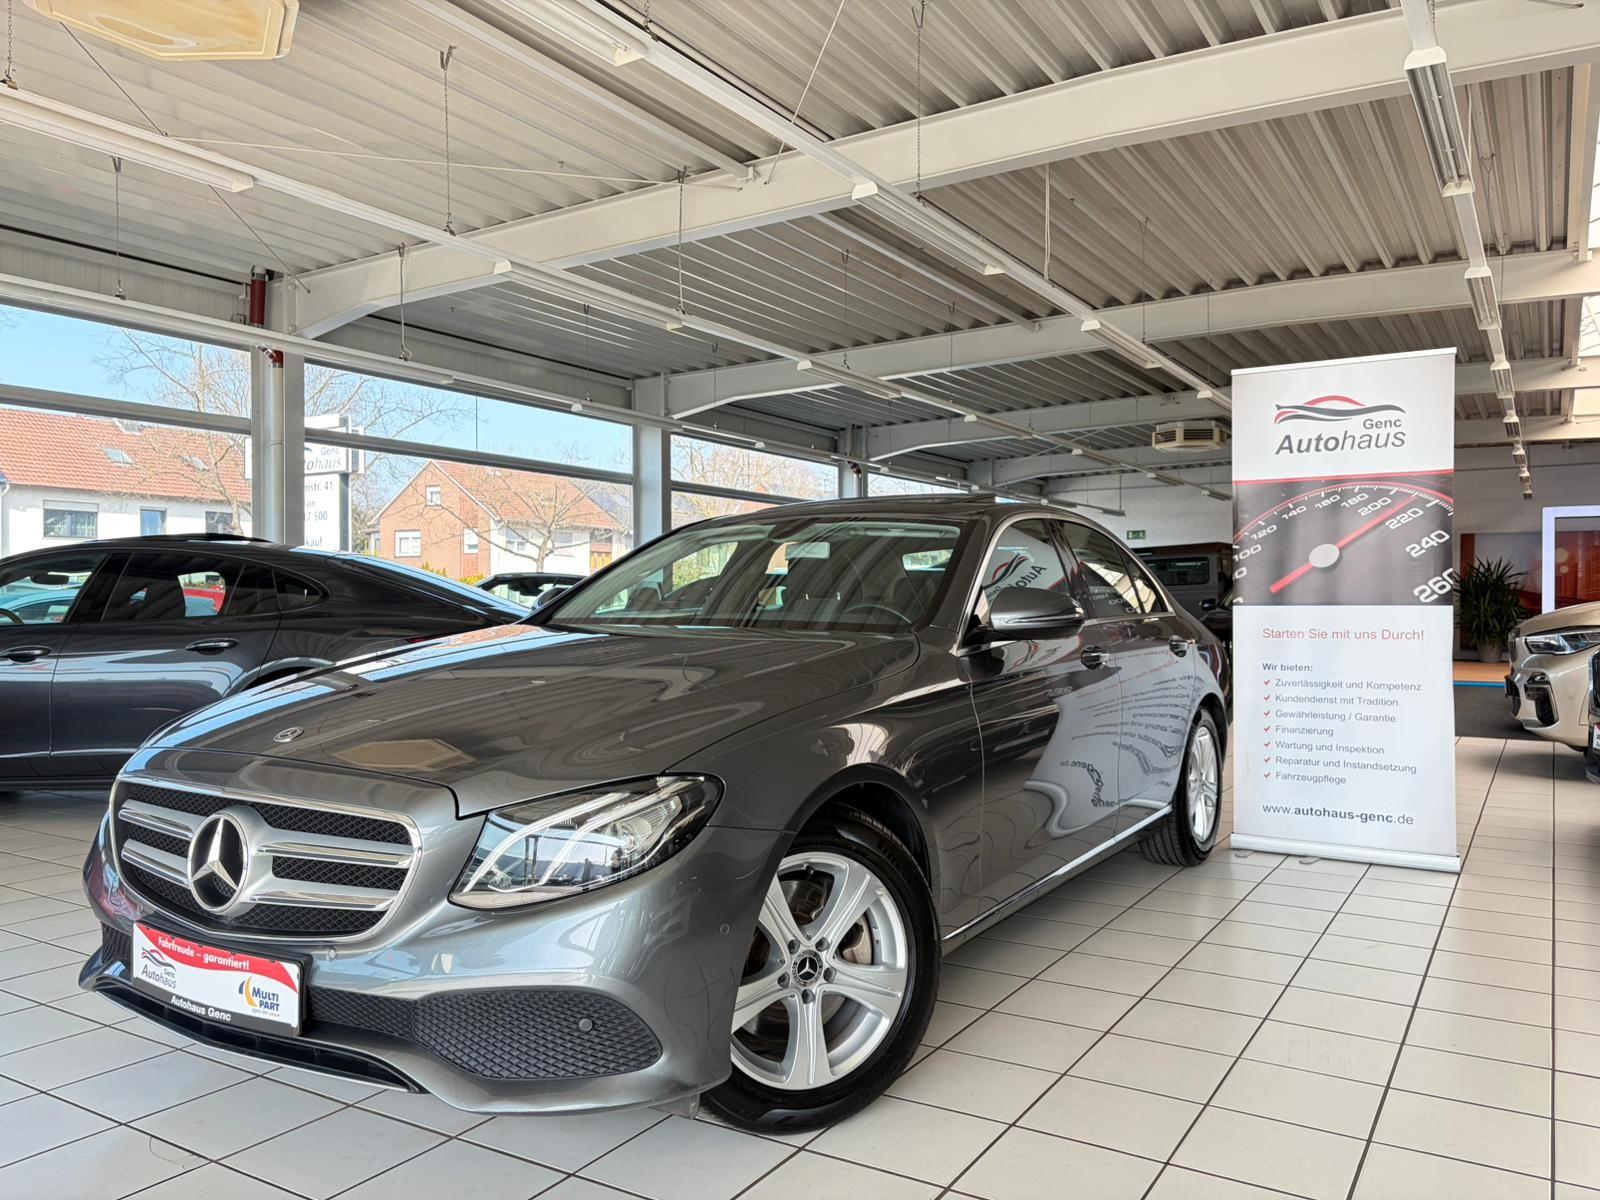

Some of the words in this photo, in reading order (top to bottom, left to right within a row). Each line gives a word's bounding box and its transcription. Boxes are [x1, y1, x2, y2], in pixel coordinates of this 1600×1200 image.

[1362, 418, 1402, 430] Genc
[1275, 430, 1406, 455] Autohaus
[305, 457, 342, 471] ohaus
[305, 483, 321, 492] nstr.
[1315, 495, 1341, 508] 160
[1341, 493, 1369, 508] 180
[1358, 497, 1392, 516] 200
[1282, 506, 1308, 520] 140
[1386, 507, 1424, 530] 220
[1250, 524, 1278, 541] 120
[305, 536, 322, 547] kauf
[1406, 530, 1450, 559] 240
[1233, 544, 1262, 562] 100
[1262, 629, 1304, 639] Starten
[1309, 629, 1327, 639] Sie
[1332, 630, 1350, 640] mit
[1355, 631, 1377, 640] uns
[1382, 630, 1424, 641] Durch!
[1262, 663, 1277, 671] Wir
[1281, 664, 1313, 672] bieten:
[1275, 678, 1343, 690] Zuverlässigkeit
[1346, 681, 1364, 689] und
[1366, 681, 1422, 692] Kompetenz
[1275, 695, 1337, 705] Kundendienst
[1340, 697, 1354, 705] mit
[1357, 697, 1399, 706] Tradition
[1275, 710, 1346, 722] Gewährleistung
[1355, 713, 1396, 722] Garantie
[1275, 726, 1334, 737] Finanzierung
[1275, 741, 1313, 752] Wartung
[1316, 743, 1333, 752] und
[1336, 745, 1384, 755] Inspektion
[1275, 757, 1320, 767] Reparatur
[1323, 759, 1340, 768] und
[1343, 761, 1416, 774] Instandsetzung
[1275, 772, 1347, 784] Fahrzeugpflege
[1262, 803, 1414, 825] www.autohaus-genc.de
[157, 935, 195, 958] Fahrfreude
[203, 953, 250, 971] garantiert!
[141, 964, 176, 989] Autohaus
[163, 968, 176, 978] Genc
[252, 986, 279, 1002] MULTI
[170, 995, 206, 1015] Autohaus
[208, 1008, 232, 1022] Genc
[259, 1000, 280, 1012] PART
